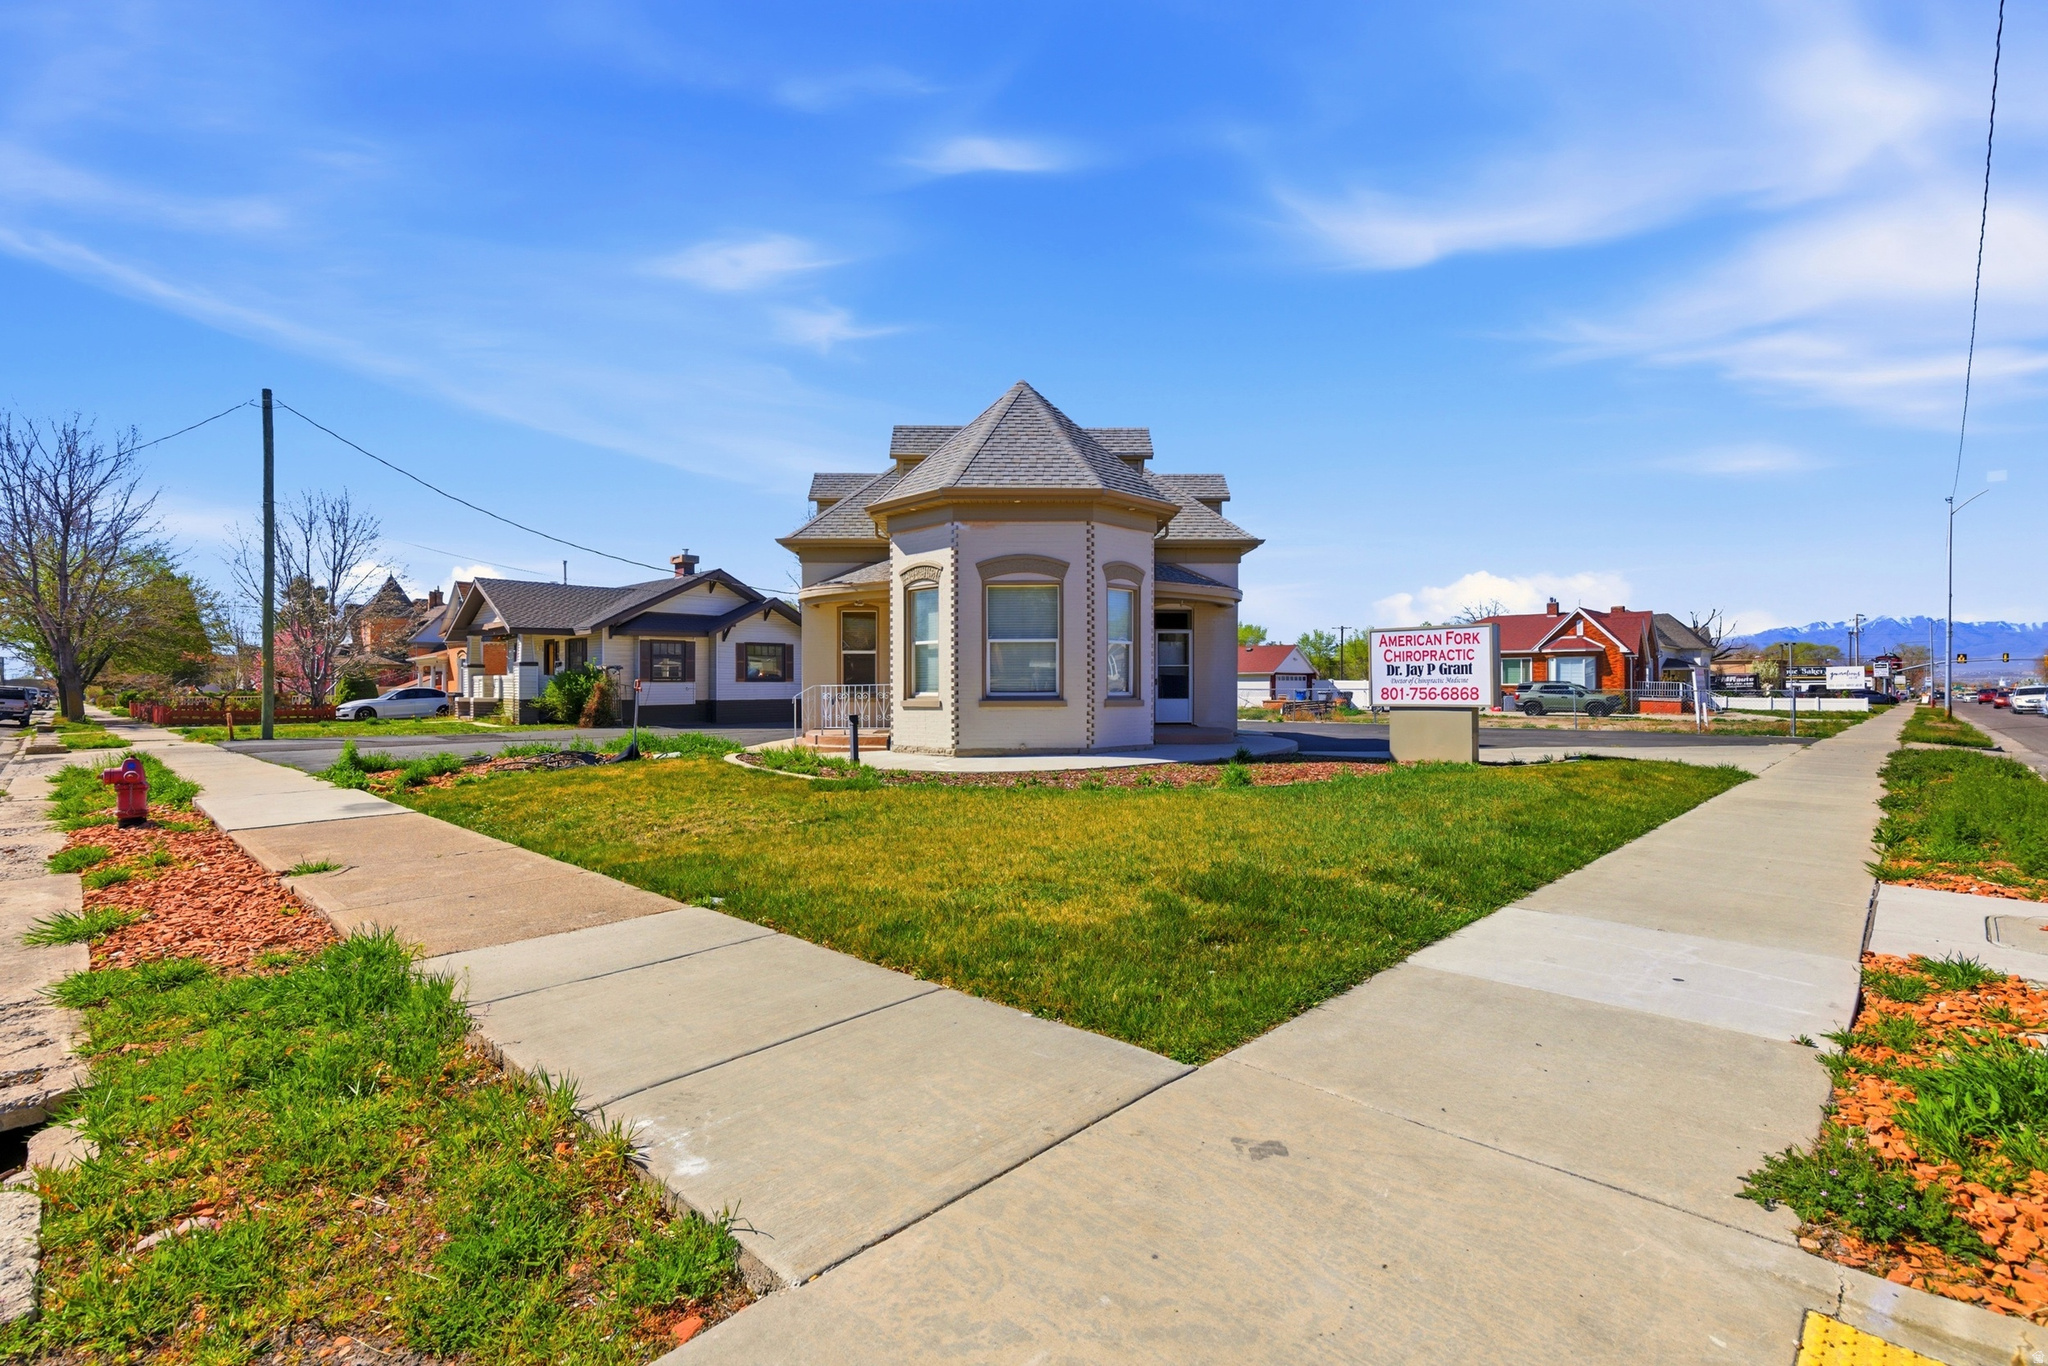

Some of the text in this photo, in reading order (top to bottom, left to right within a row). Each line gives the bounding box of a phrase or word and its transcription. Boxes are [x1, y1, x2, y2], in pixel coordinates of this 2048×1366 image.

[1379, 631, 1480, 647] AMERICAN FORK
[1384, 649, 1475, 662] CHIROPRACTIC
[1387, 663, 1472, 677] Dr. Jay P Grant
[1407, 677, 1413, 686] of
[1414, 677, 1444, 685] Chiropractic
[1445, 676, 1468, 684] Medicine
[1381, 687, 1479, 700] 801-756-6868
